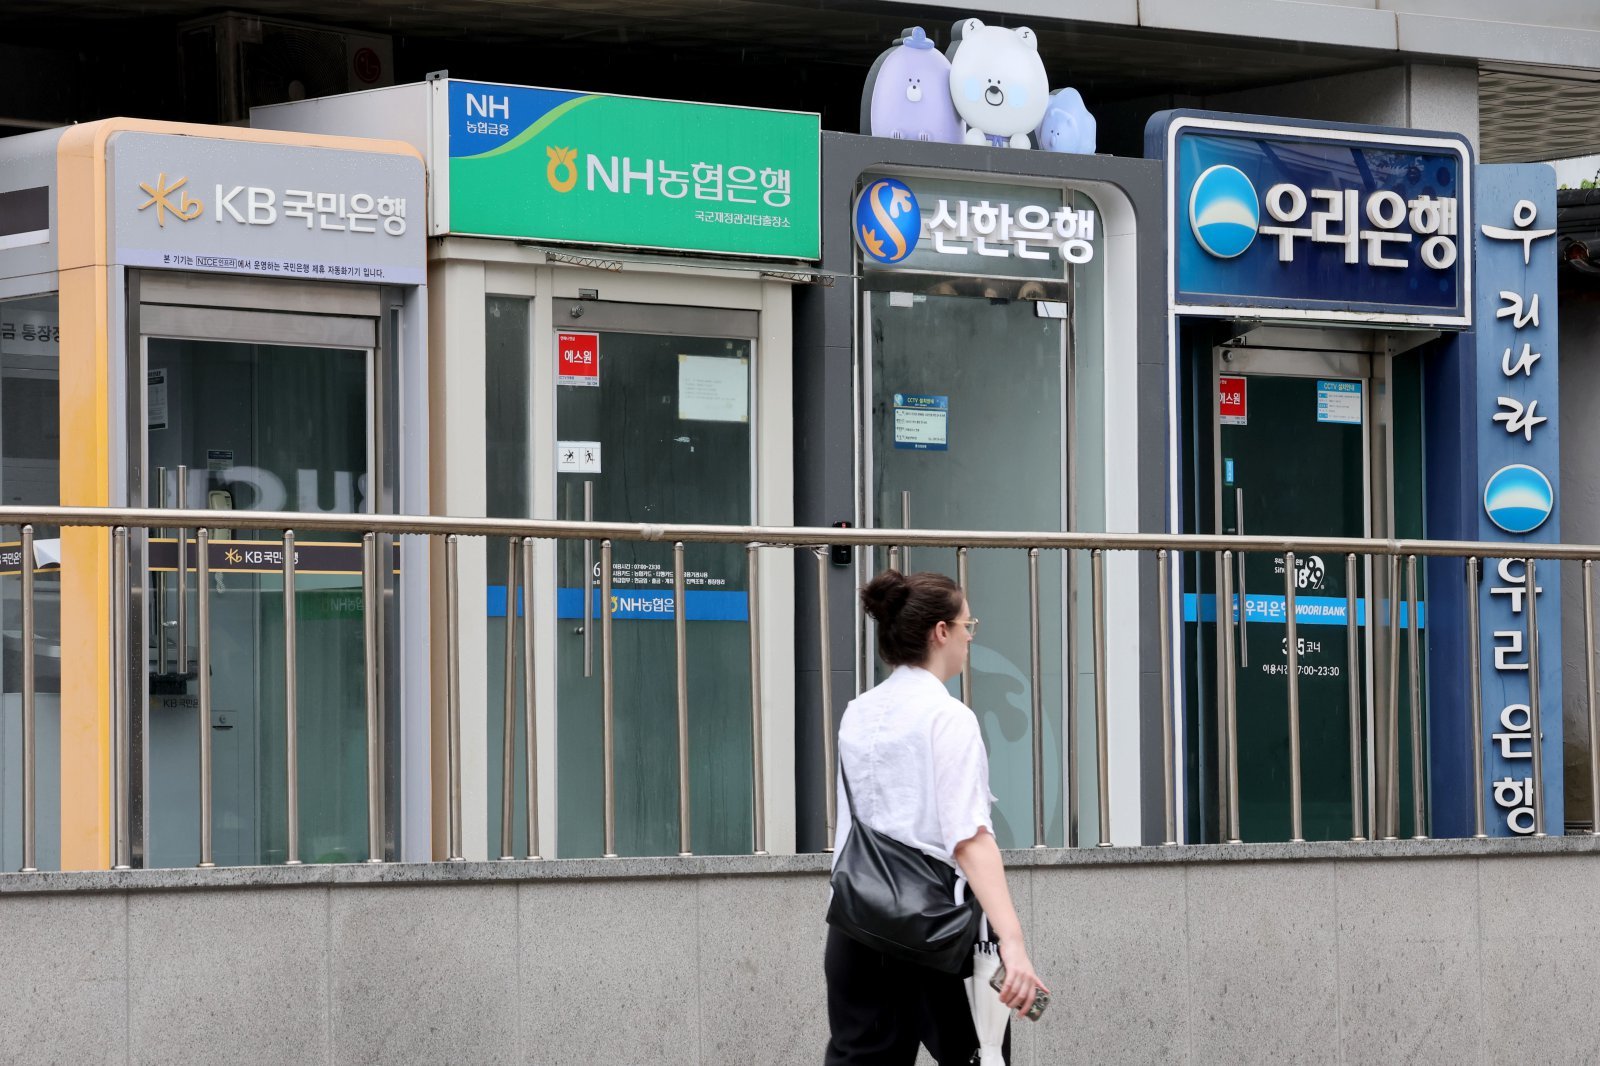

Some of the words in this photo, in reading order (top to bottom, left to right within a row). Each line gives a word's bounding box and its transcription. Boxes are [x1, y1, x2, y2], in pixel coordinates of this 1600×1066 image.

[466, 93, 509, 120] NH
[466, 121, 509, 136] 농협금융
[586, 153, 791, 208] NH농협은행
[694, 210, 791, 228] 국군재정관리단출장소
[1259, 183, 1457, 270] 우리은행
[928, 199, 1095, 264] 신한은행
[163, 254, 170, 264] 본
[173, 256, 194, 266] 기기는
[254, 261, 280, 272] 운영하는
[283, 262, 310, 274] 국민은행
[312, 264, 325, 274] 제휴
[328, 265, 361, 277] 자동화기기
[363, 267, 385, 278] 입니다.
[564, 349, 592, 364] 에스원
[620, 597, 675, 613] NH농협은
[1295, 604, 1321, 615] WOORI
[1322, 605, 1346, 616] BANK
[1306, 641, 1321, 653] 코너
